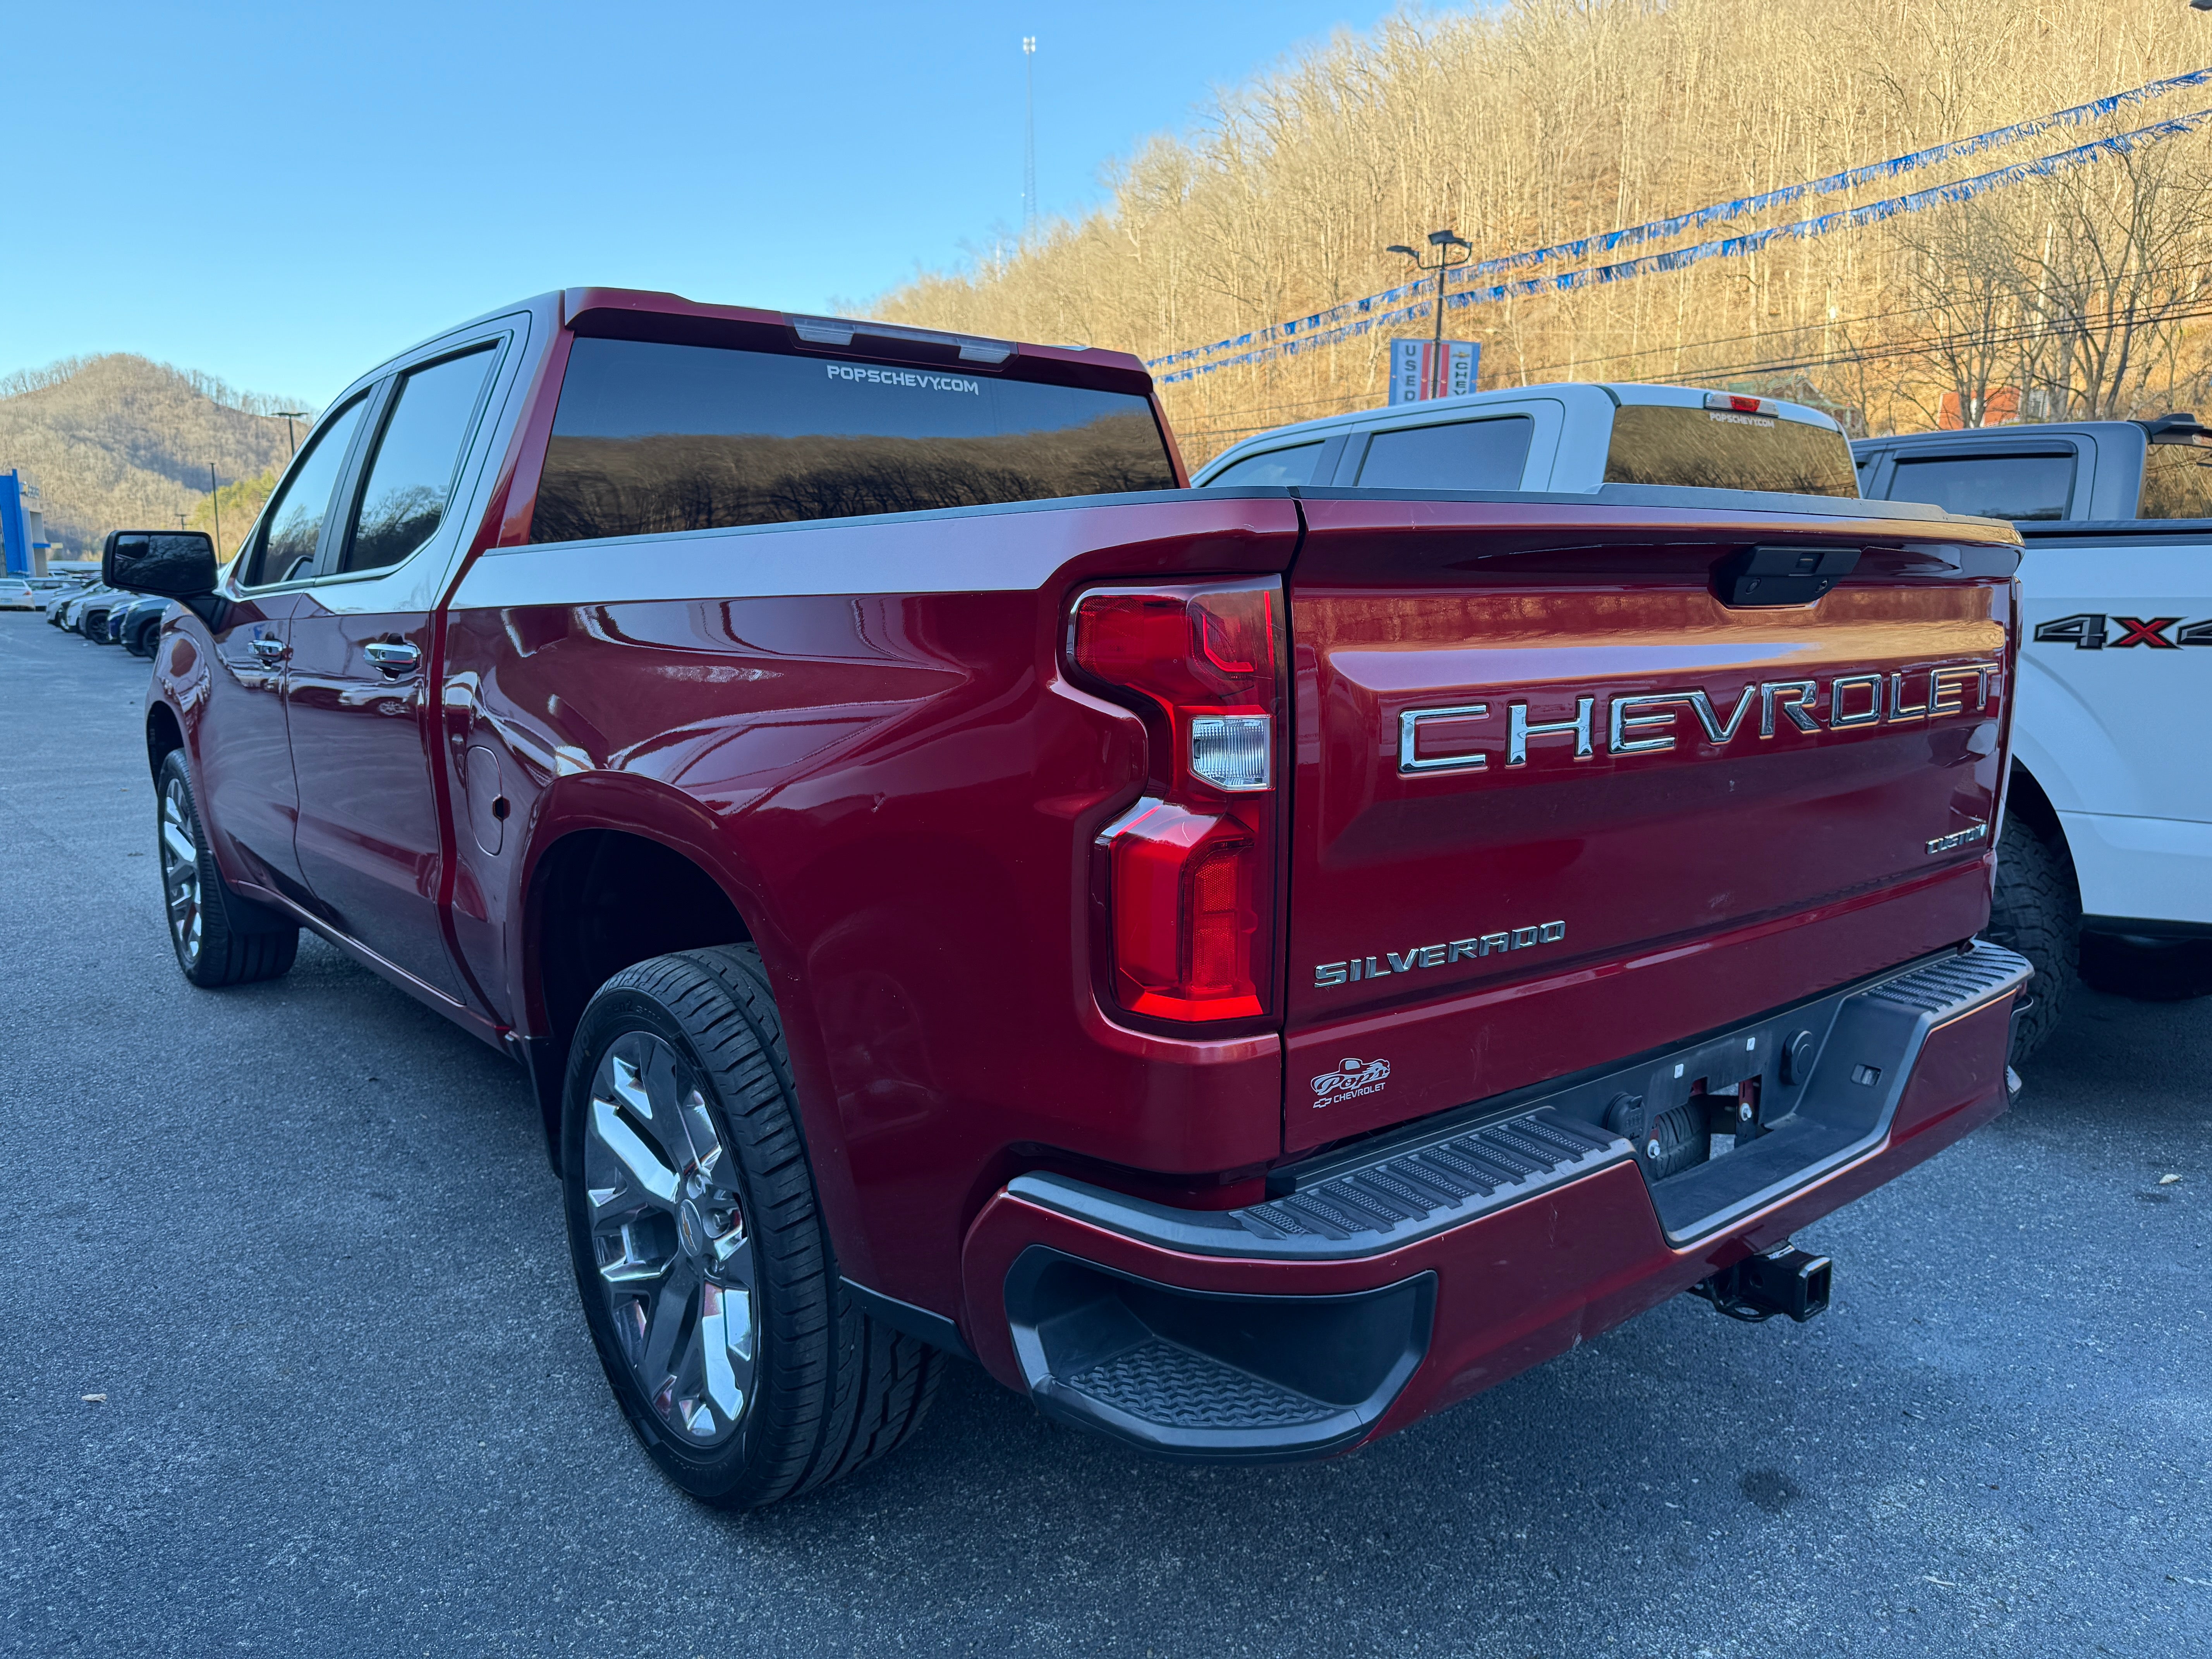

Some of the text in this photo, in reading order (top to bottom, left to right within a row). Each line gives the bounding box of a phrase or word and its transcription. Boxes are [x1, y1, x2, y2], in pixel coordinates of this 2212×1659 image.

[826, 365, 979, 395] POPSCHEVY.COM
[1405, 345, 1417, 402] USED
[1398, 663, 1999, 776] CHEVROLET
[1314, 920, 1566, 988] SILVERADO
[1334, 1082, 1385, 1103] CHEVROLET
